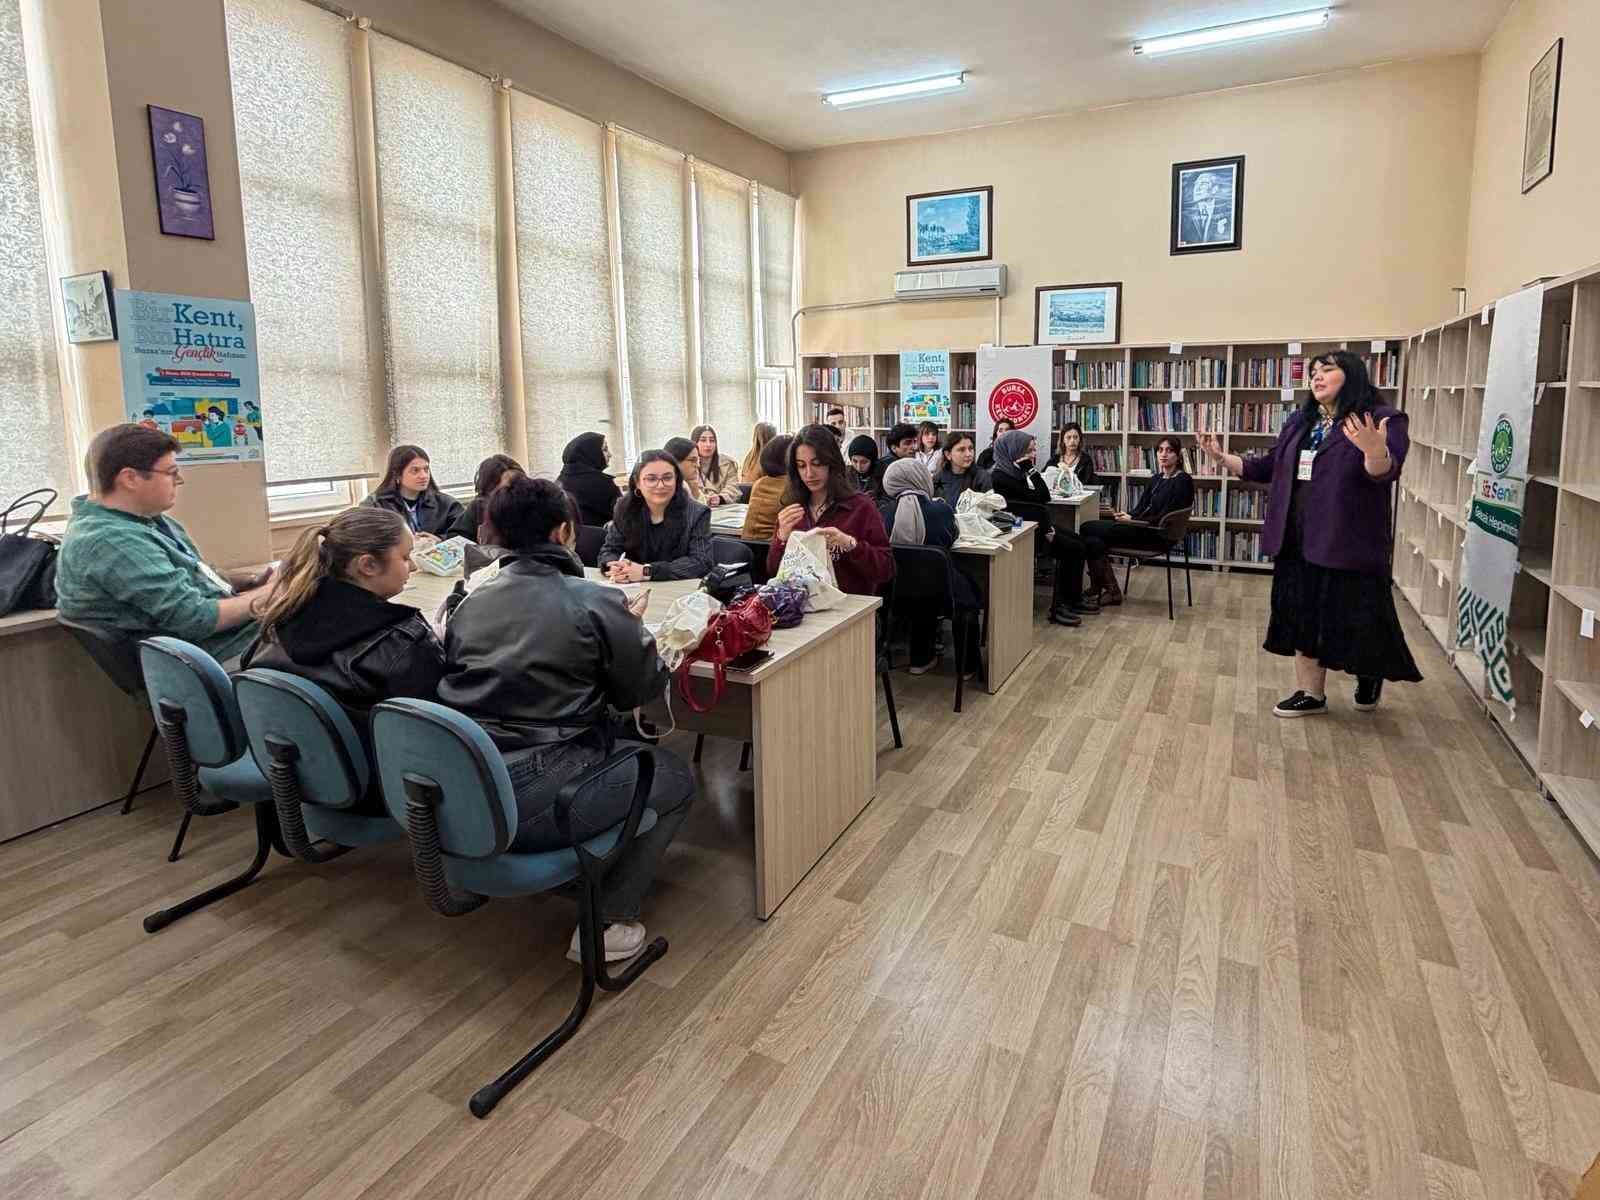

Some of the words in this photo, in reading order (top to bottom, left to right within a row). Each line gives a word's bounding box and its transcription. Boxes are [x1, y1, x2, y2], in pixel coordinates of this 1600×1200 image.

[172, 302, 243, 331] Kent,
[173, 327, 246, 349] Hatıra
[1001, 385, 1026, 396] BURSA
